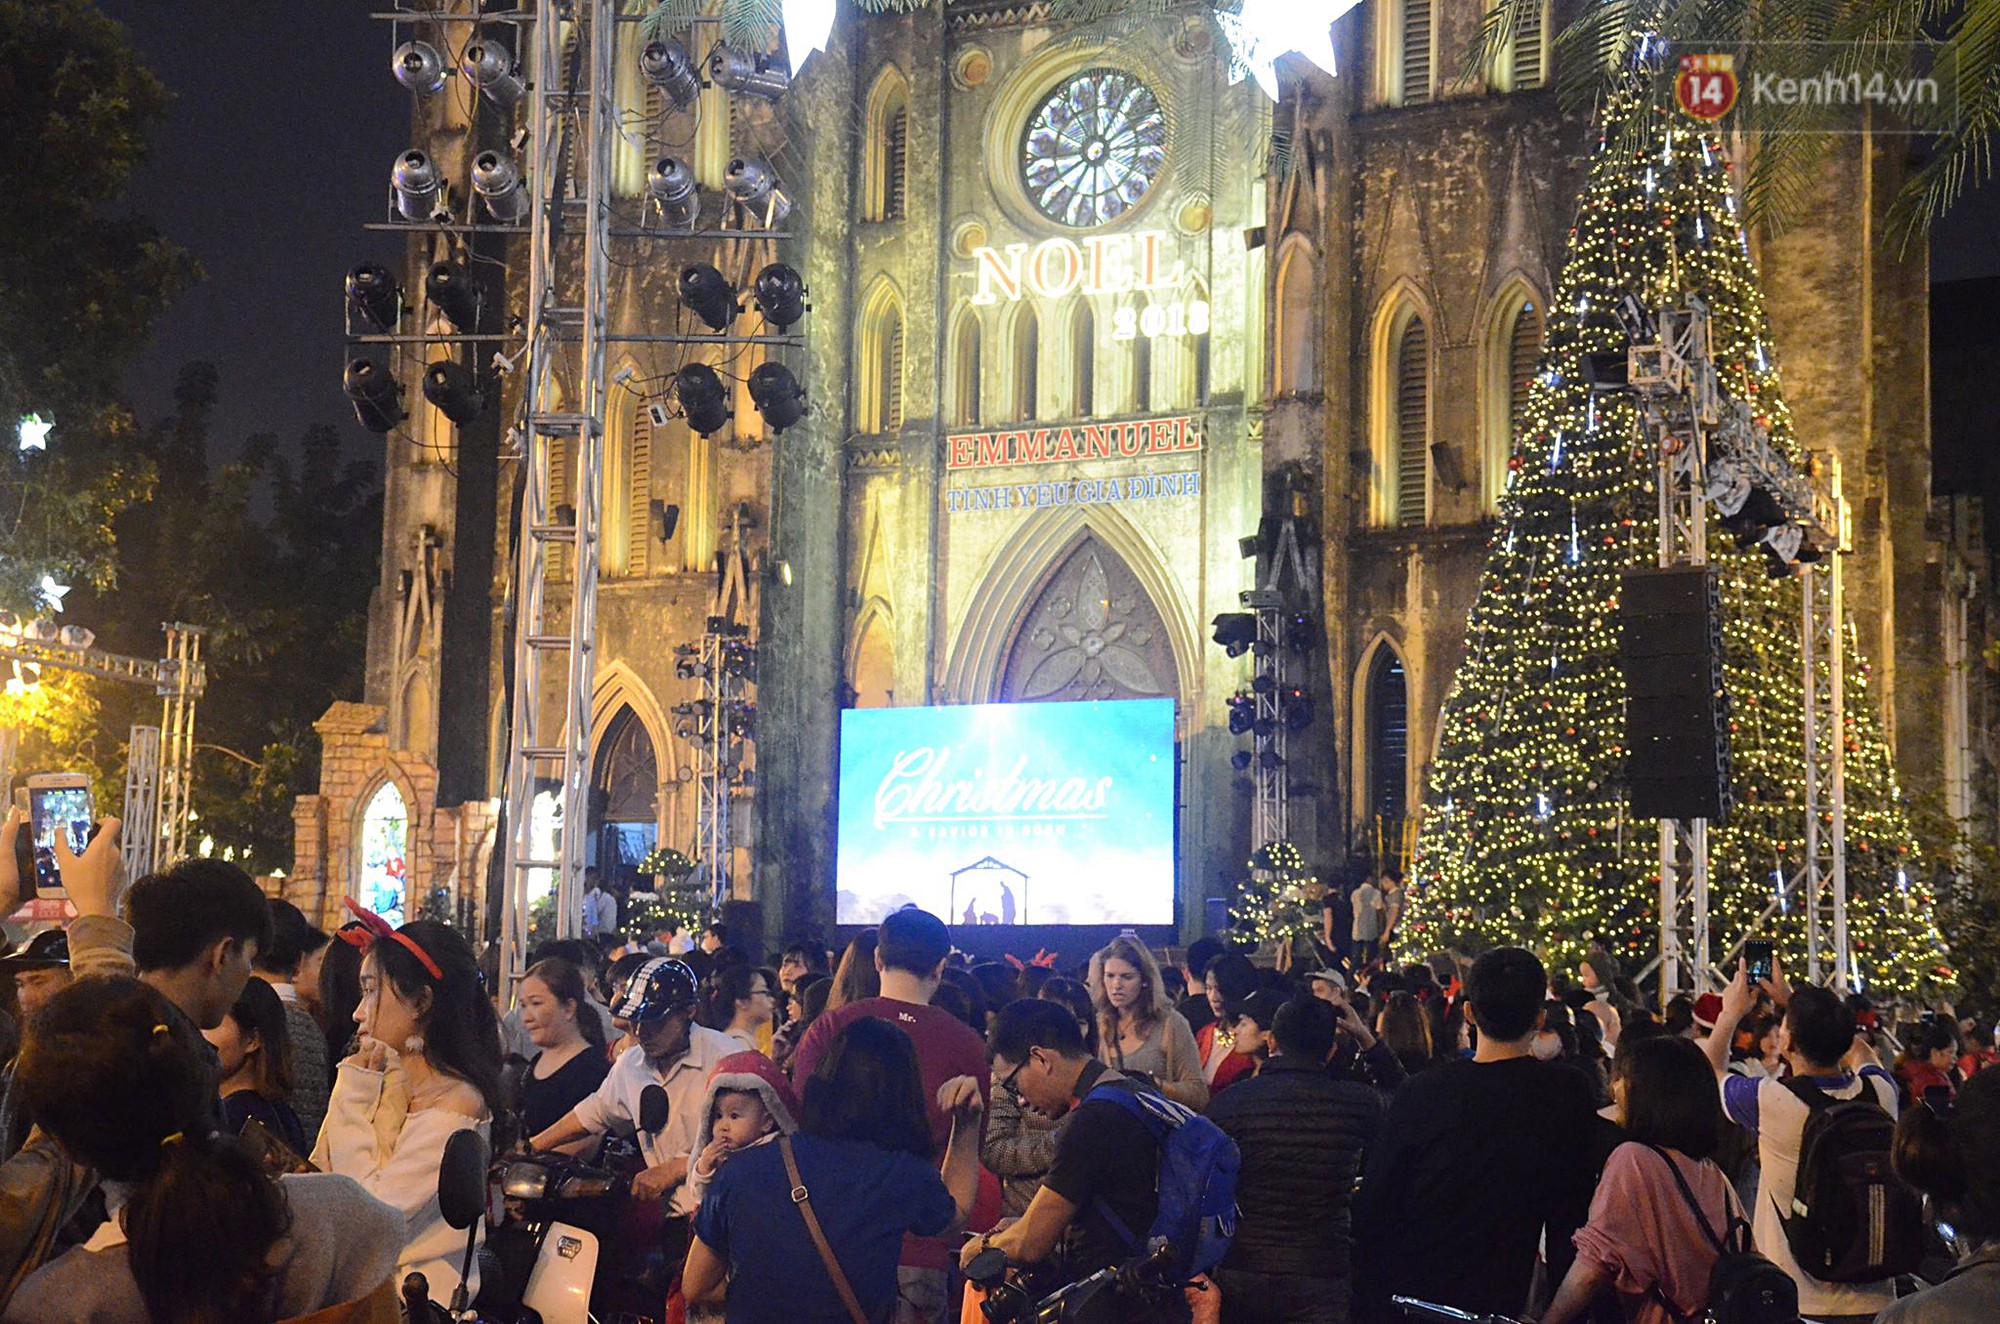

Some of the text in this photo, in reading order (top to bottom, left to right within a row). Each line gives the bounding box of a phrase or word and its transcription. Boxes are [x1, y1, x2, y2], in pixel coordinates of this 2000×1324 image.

[971, 230, 1185, 305] NOEL
[1113, 300, 1209, 340] 2018
[947, 416, 1202, 469] EMMANUEL
[947, 468, 1201, 512] TÌNH YÊU GIA ĐÌNH
[874, 747, 1113, 829] Christmas
[898, 1012, 917, 1023] Mr.
